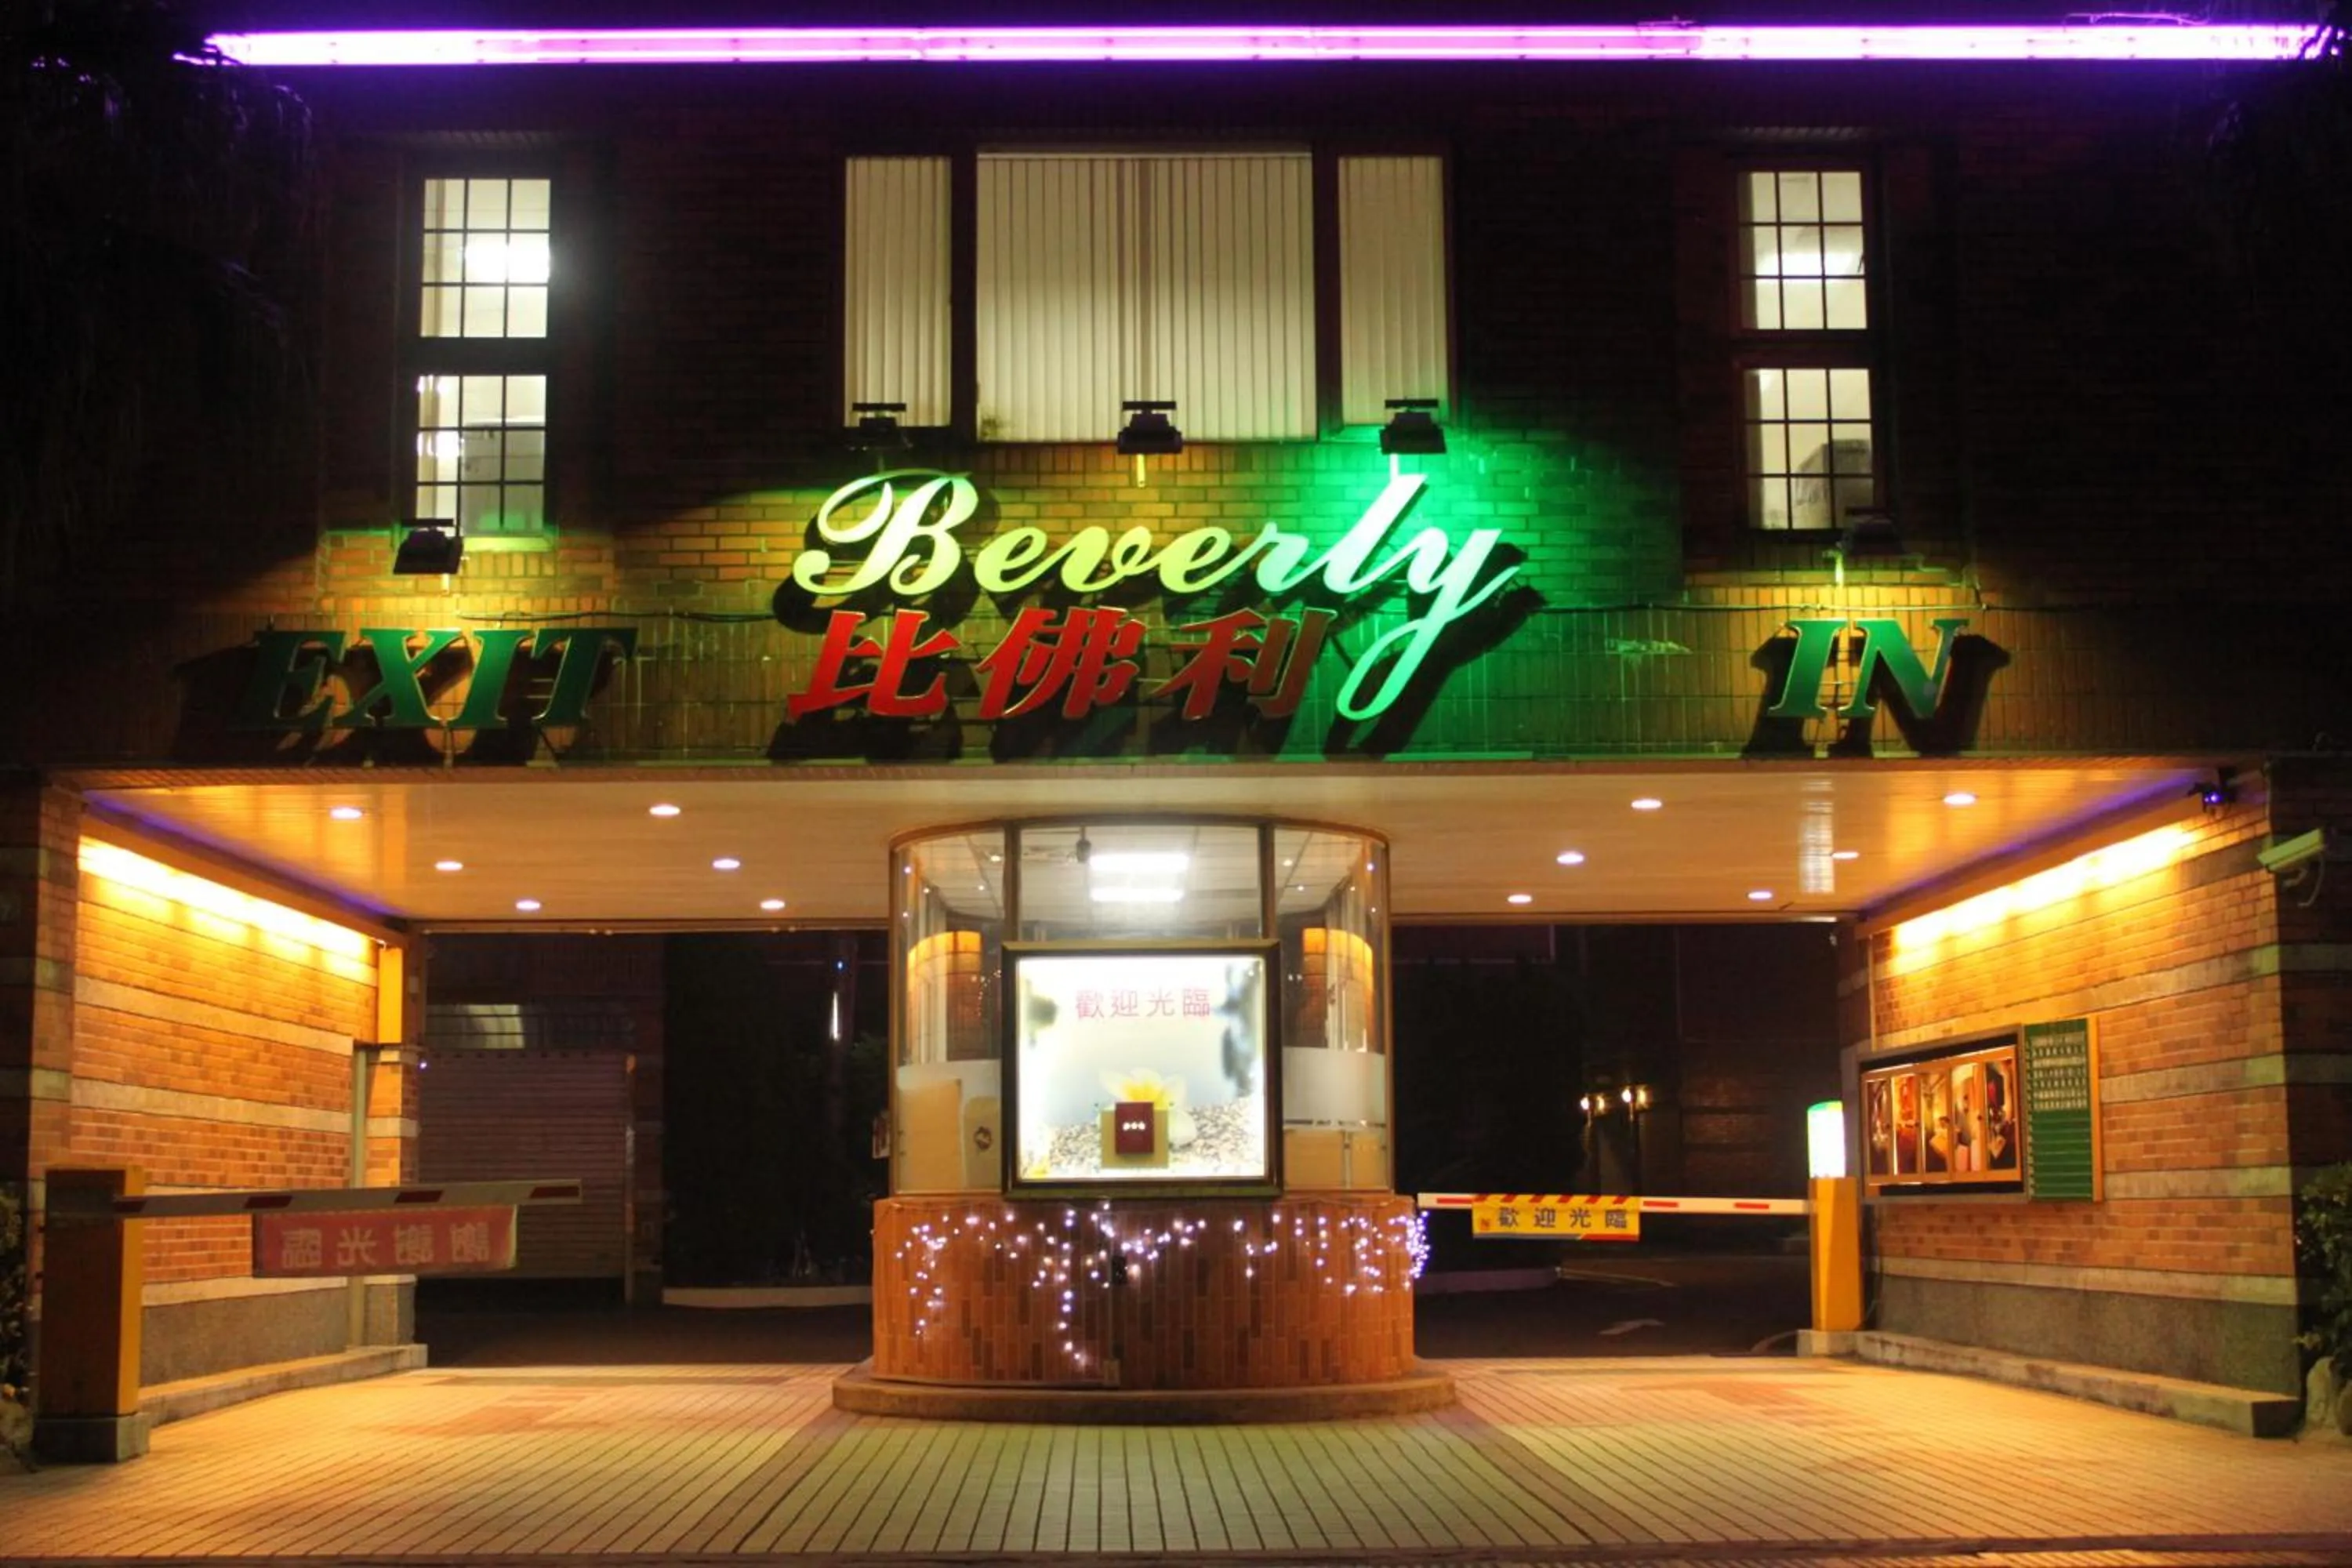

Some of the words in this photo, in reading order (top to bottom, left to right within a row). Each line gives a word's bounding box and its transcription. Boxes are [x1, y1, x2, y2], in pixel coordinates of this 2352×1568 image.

[793, 470, 1522, 720] Beverly
[227, 628, 637, 728] EXIT
[787, 607, 1338, 720] 比佛利
[1769, 619, 1969, 717] IN
[1076, 989, 1210, 1018] 歡迎光臨
[1499, 1207, 1628, 1229] 歡迎光臨
